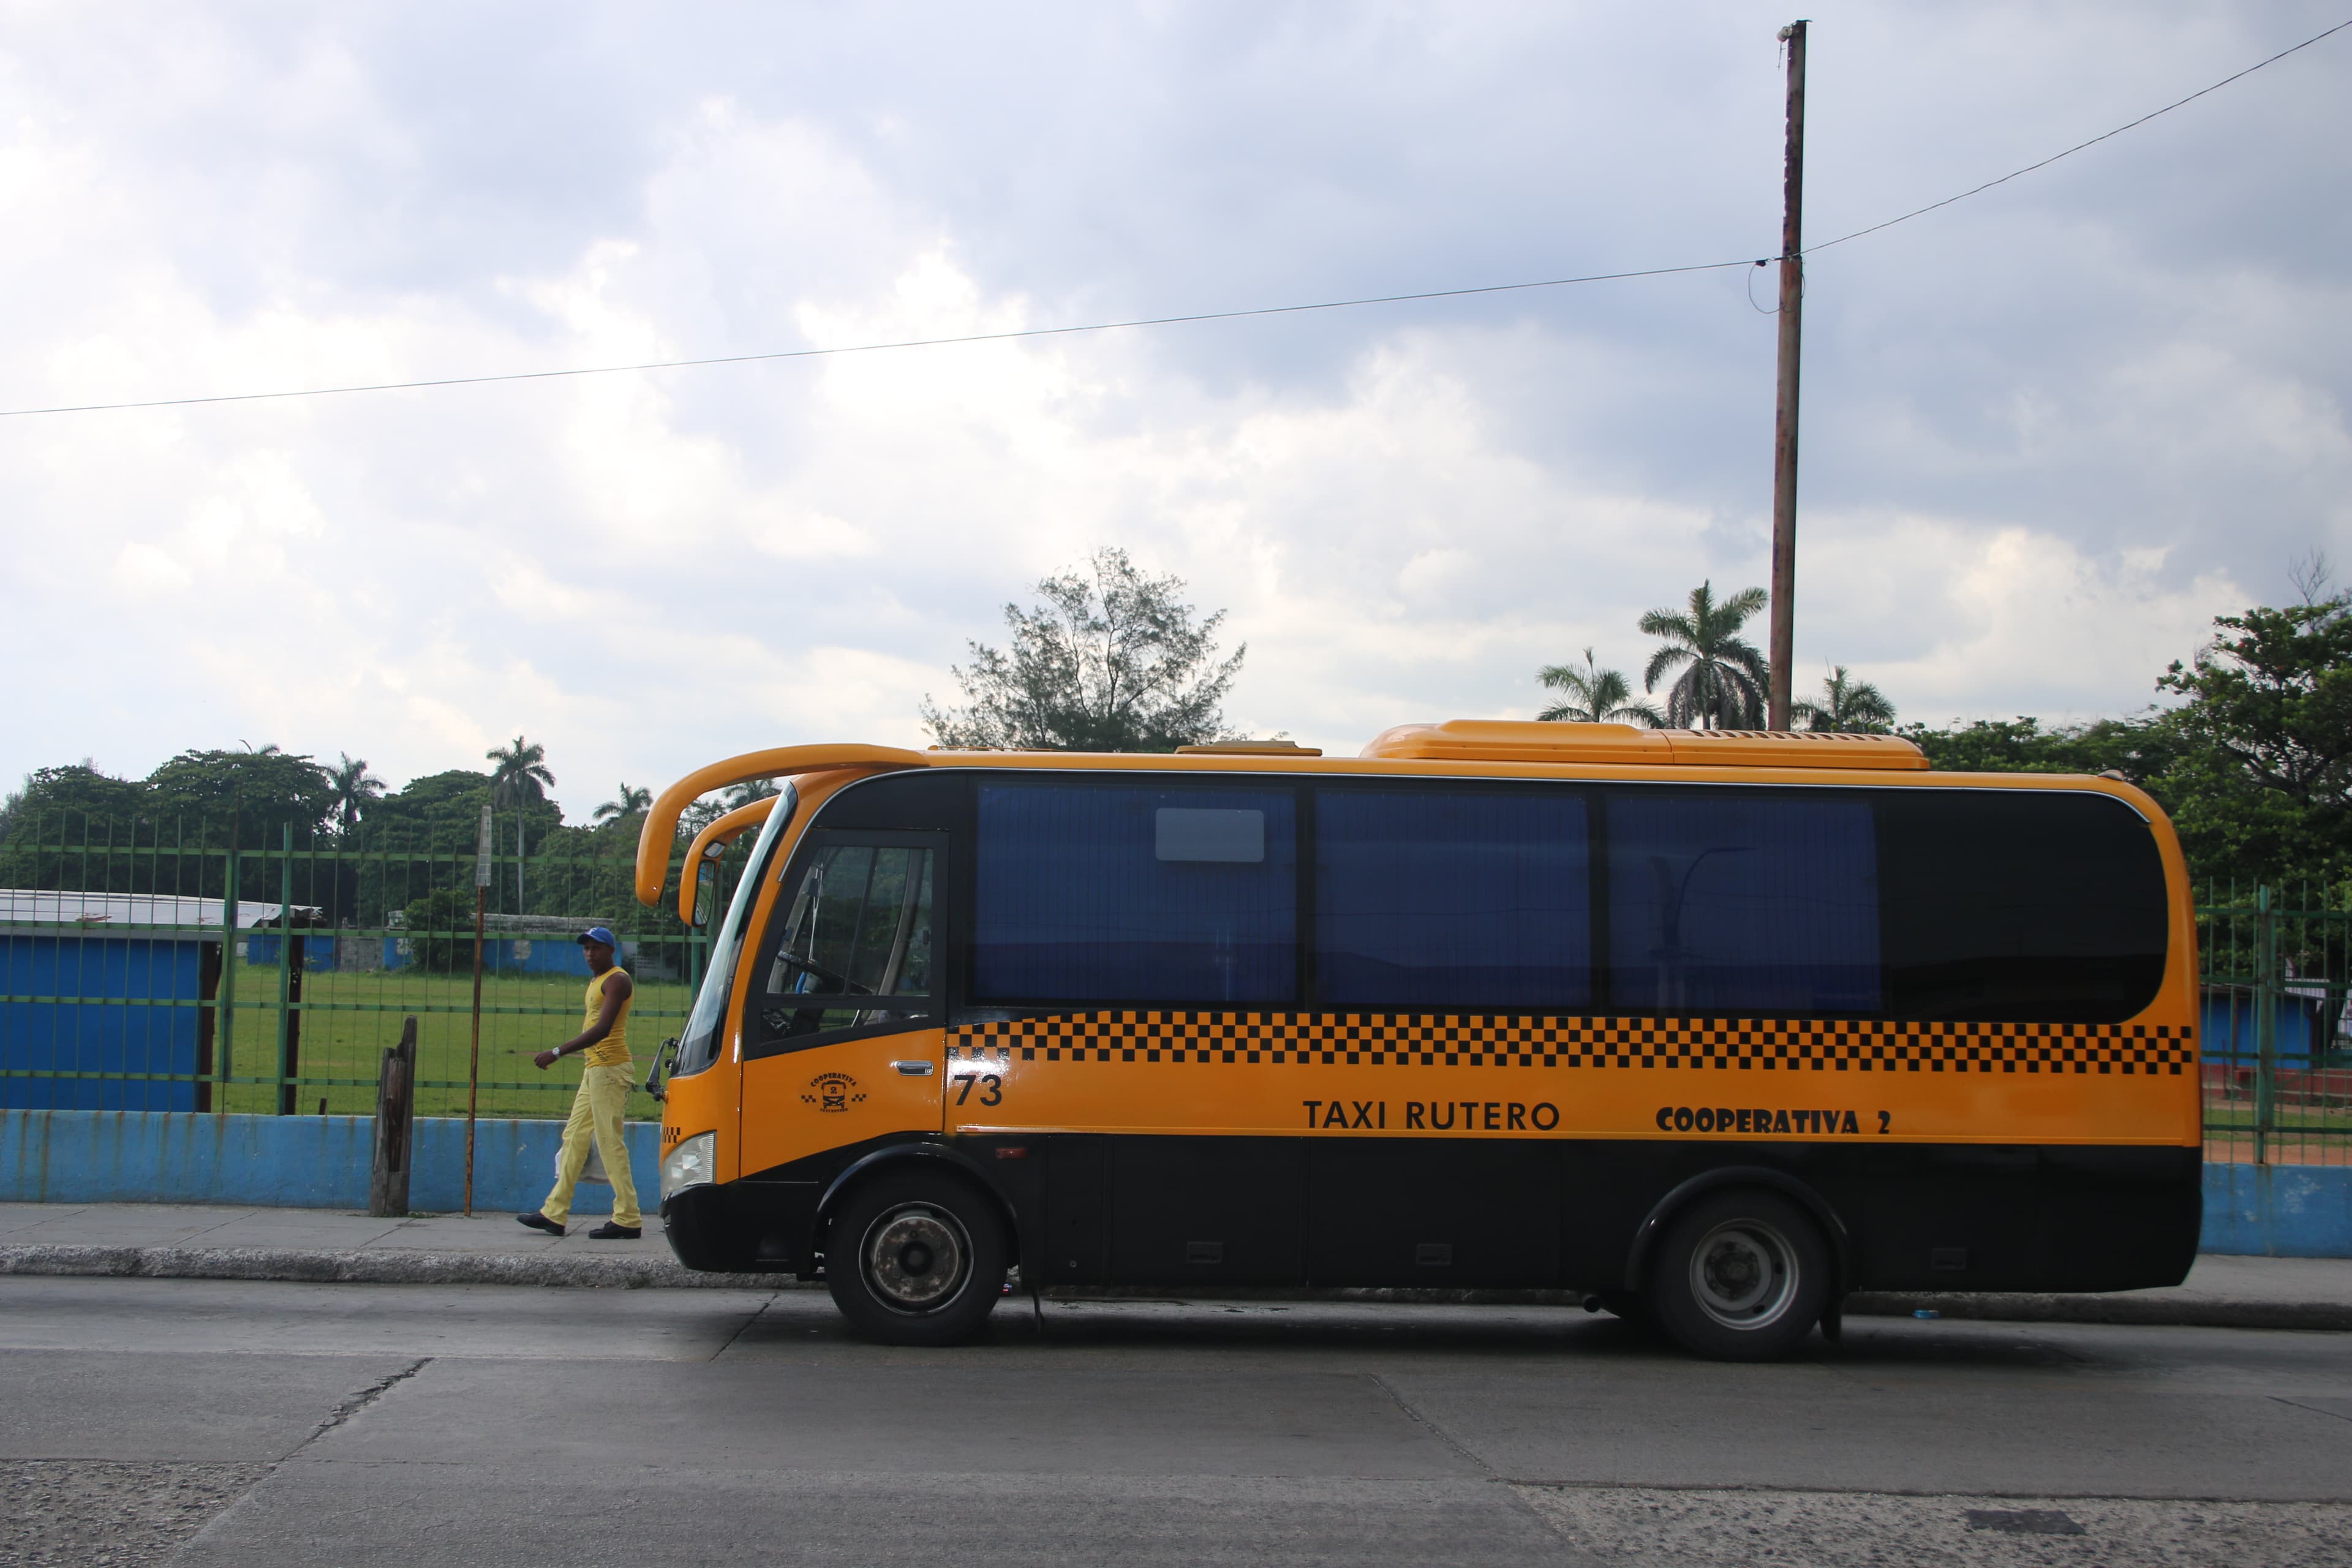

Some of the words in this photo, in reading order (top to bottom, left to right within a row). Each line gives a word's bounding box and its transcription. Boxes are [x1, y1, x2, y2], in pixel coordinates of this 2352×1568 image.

[810, 1072, 857, 1087] COOPERATIVA
[954, 1074, 1003, 1107] 73
[1303, 1101, 1385, 1129] TAXI
[1406, 1101, 1560, 1131] RUTERO
[1656, 1106, 1860, 1134] COOPERATIVA
[1878, 1110, 1891, 1134] 2
